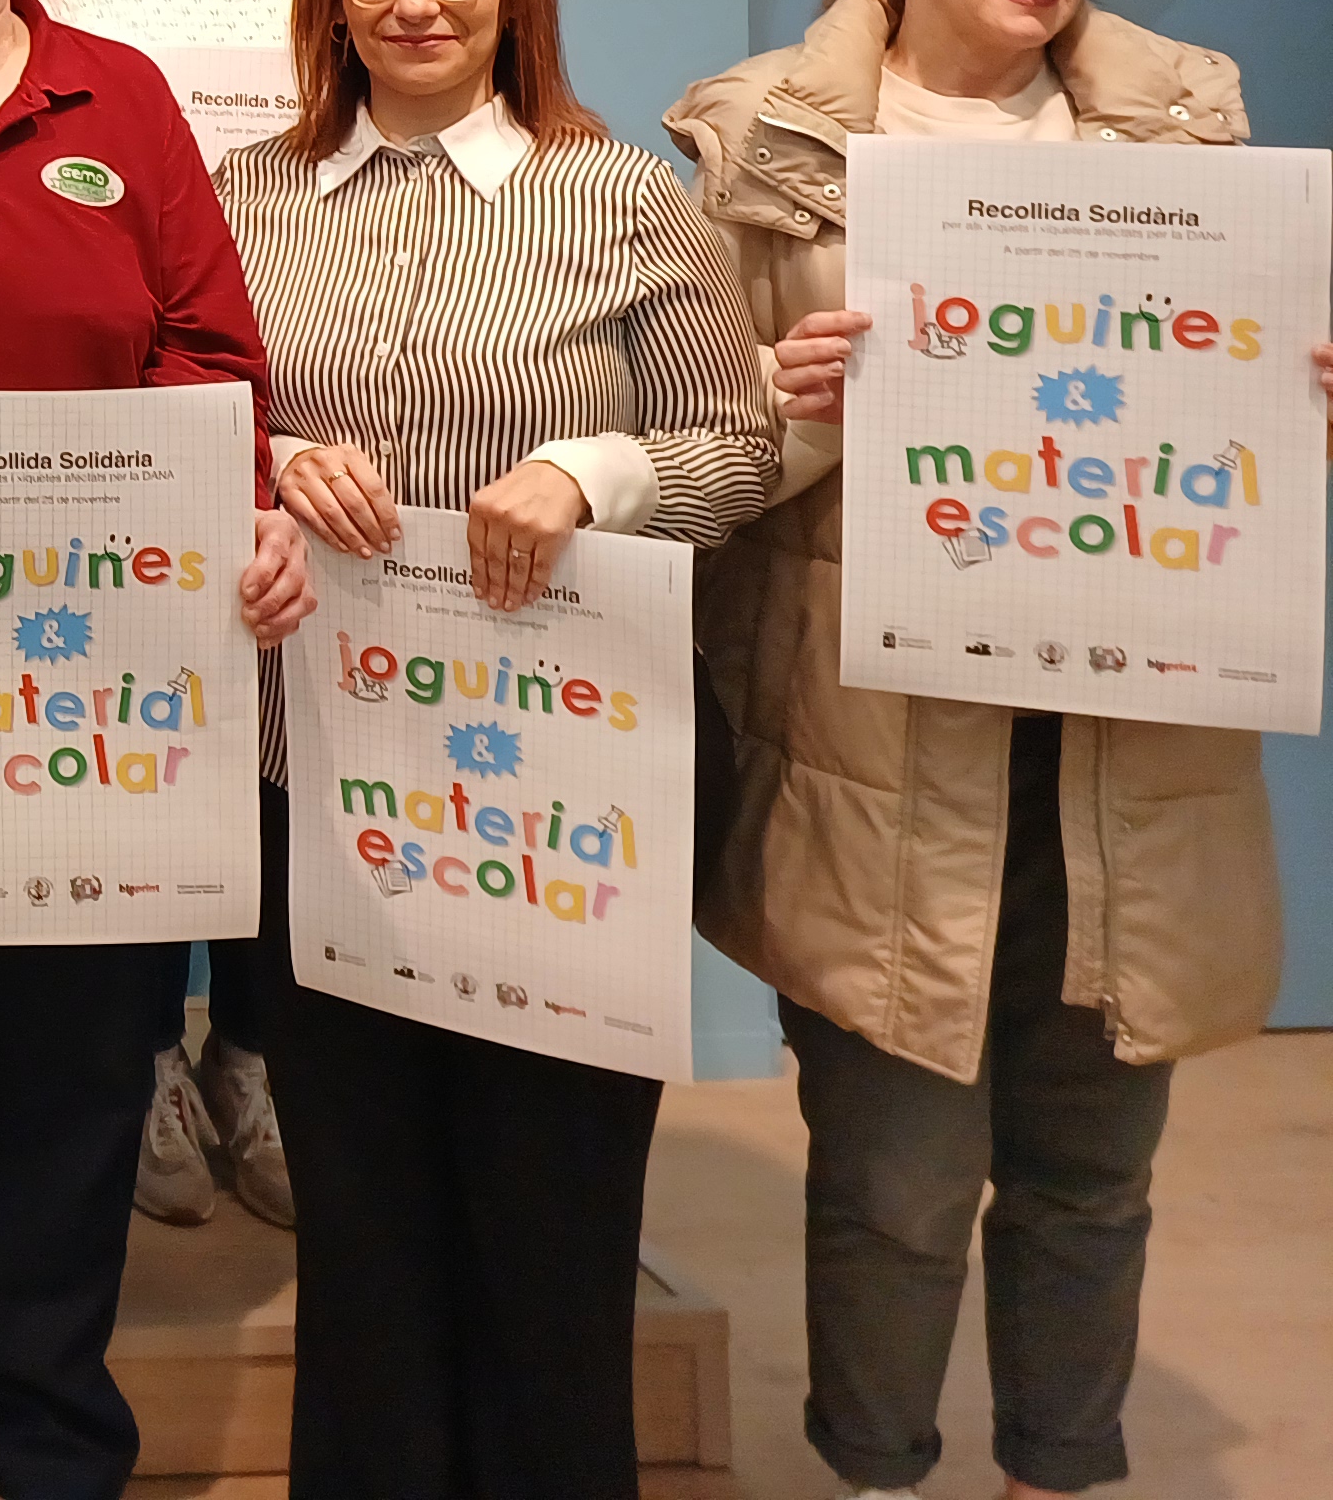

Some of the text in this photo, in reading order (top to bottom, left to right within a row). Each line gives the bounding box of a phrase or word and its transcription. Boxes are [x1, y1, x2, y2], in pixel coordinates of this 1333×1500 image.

[192, 91, 268, 108] Recollida
[968, 199, 1199, 227] Recollida Solidària
[1064, 380, 1093, 412] &
[59, 450, 152, 469] Solidària
[905, 435, 1261, 508] material
[925, 497, 1240, 571] escolar
[39, 619, 66, 649] &
[473, 732, 496, 765] &
[339, 777, 637, 869] material
[357, 827, 622, 923] escolar
